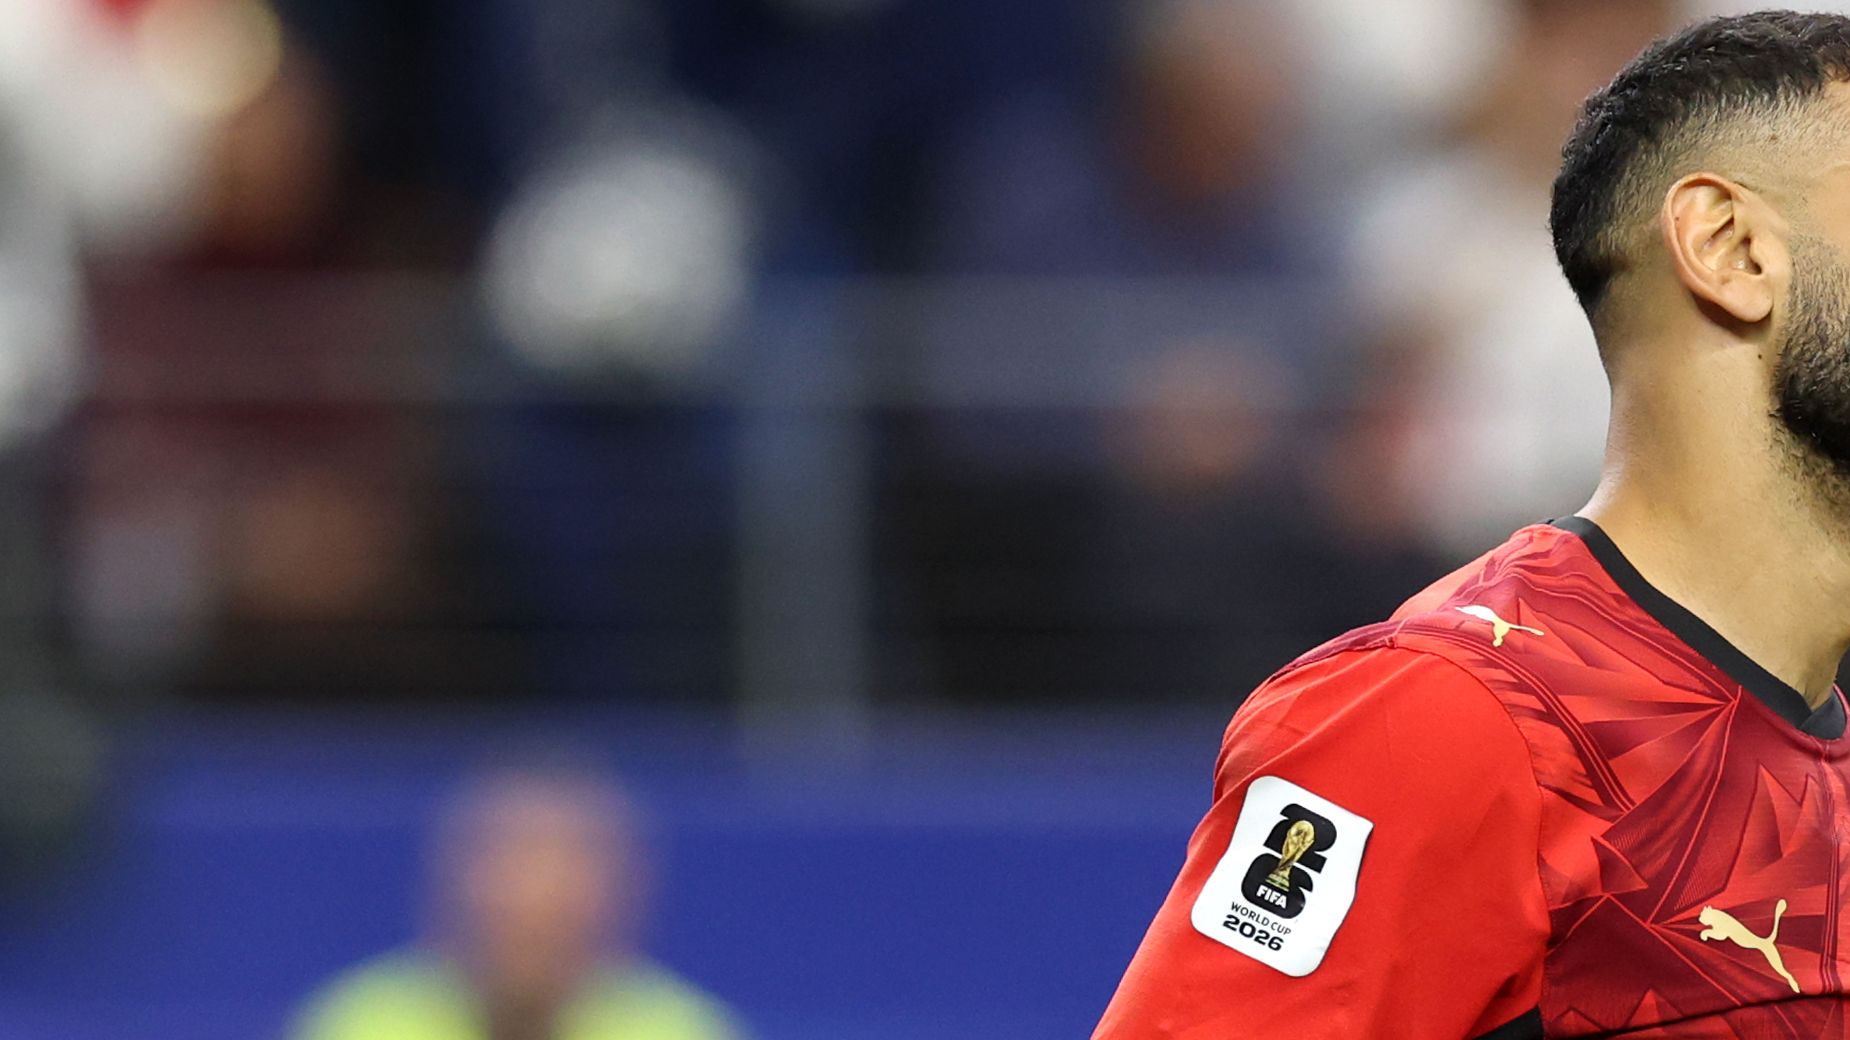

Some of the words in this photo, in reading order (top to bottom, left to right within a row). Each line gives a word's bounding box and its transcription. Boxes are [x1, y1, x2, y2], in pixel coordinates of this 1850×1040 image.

[1256, 885, 1288, 909] FIFA
[1222, 914, 1284, 951] 2026
[1231, 901, 1270, 927] WORLD
[1269, 921, 1292, 936] CUP
